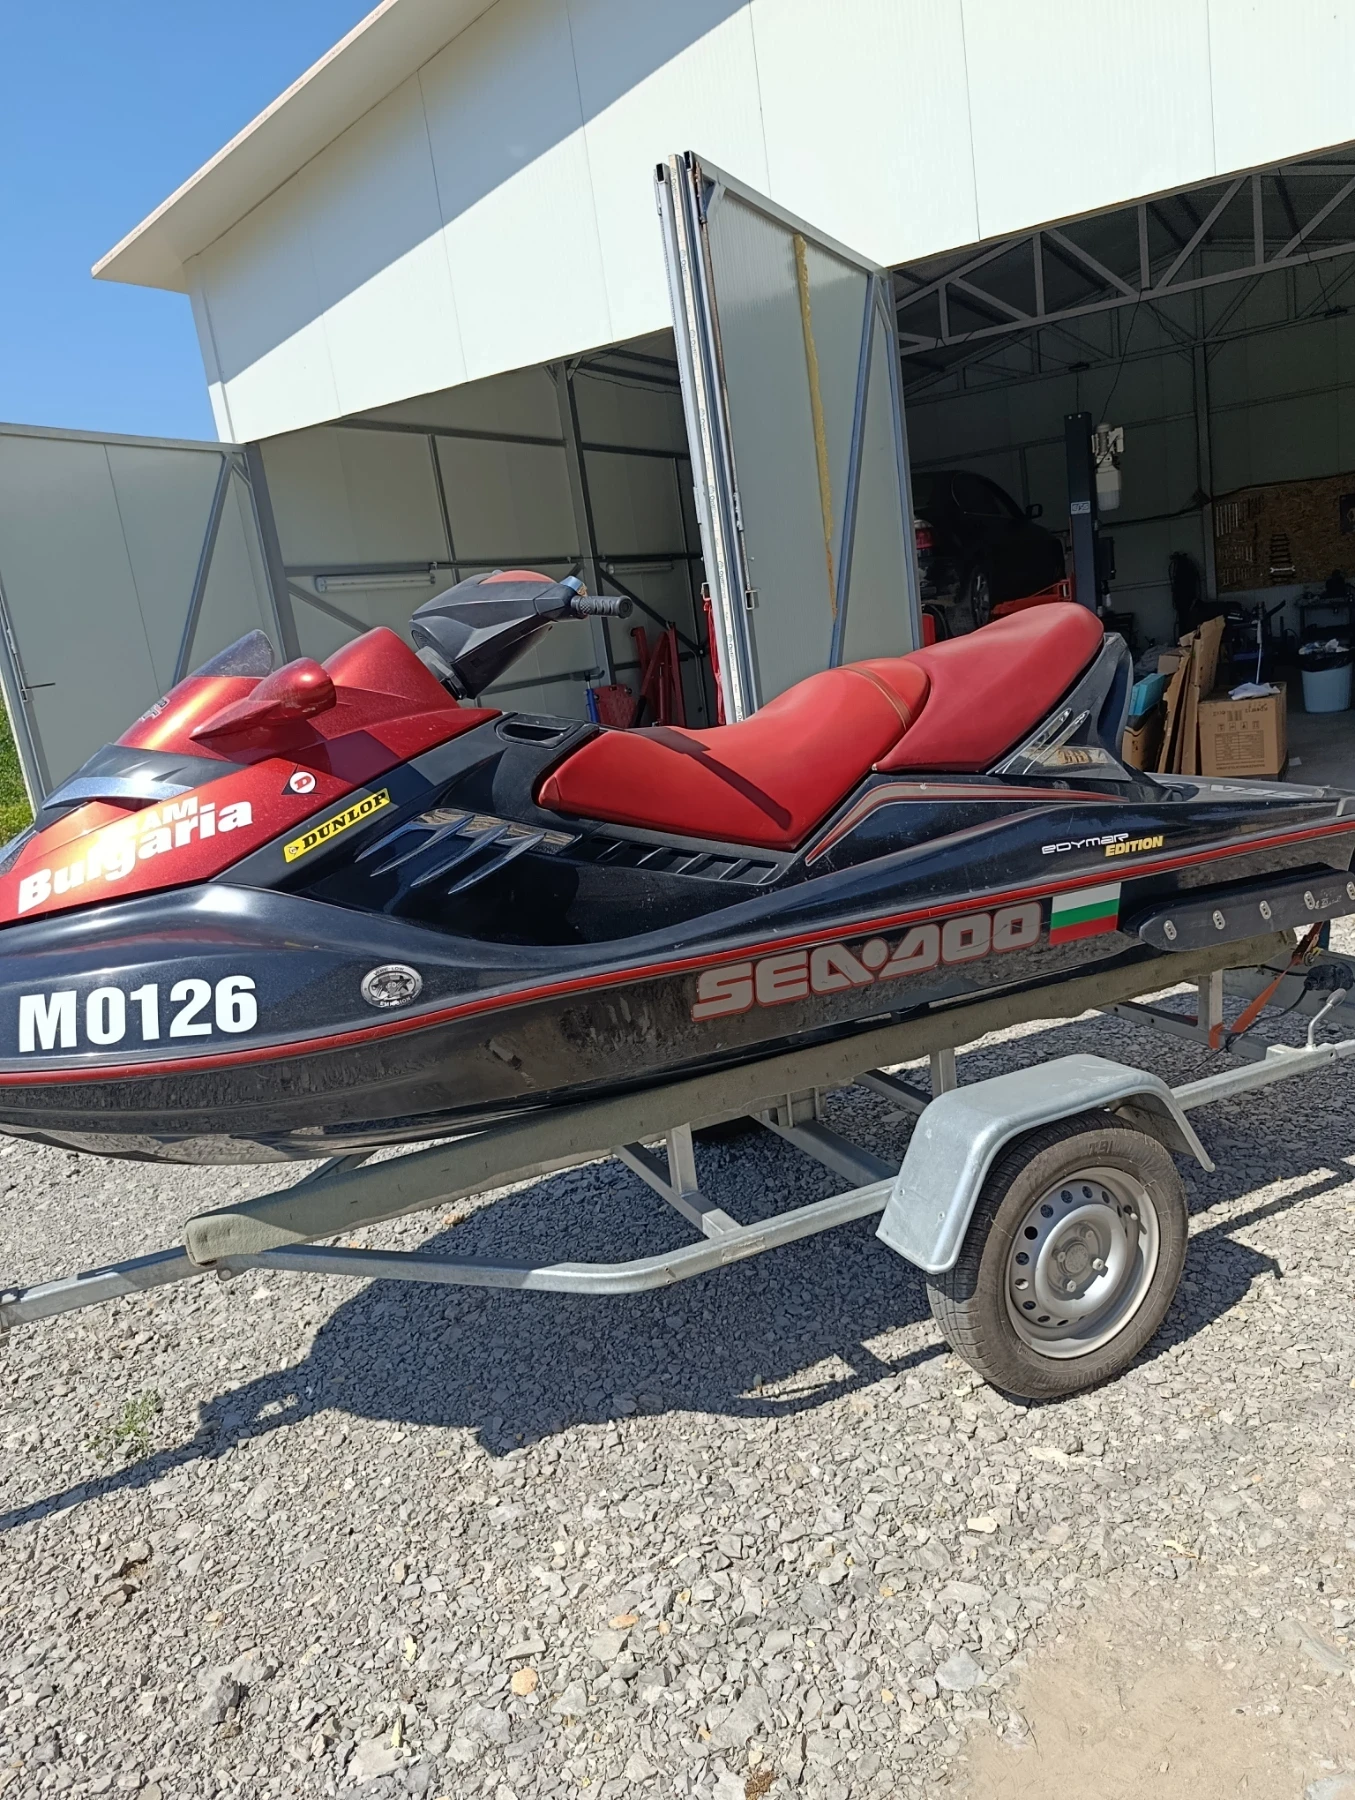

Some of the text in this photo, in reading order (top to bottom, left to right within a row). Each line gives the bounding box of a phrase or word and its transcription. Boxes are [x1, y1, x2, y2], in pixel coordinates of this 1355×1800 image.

[302, 792, 386, 849] DUNLOP
[1105, 836, 1164, 857] EDITION
[18, 801, 253, 915] Bulgaria
